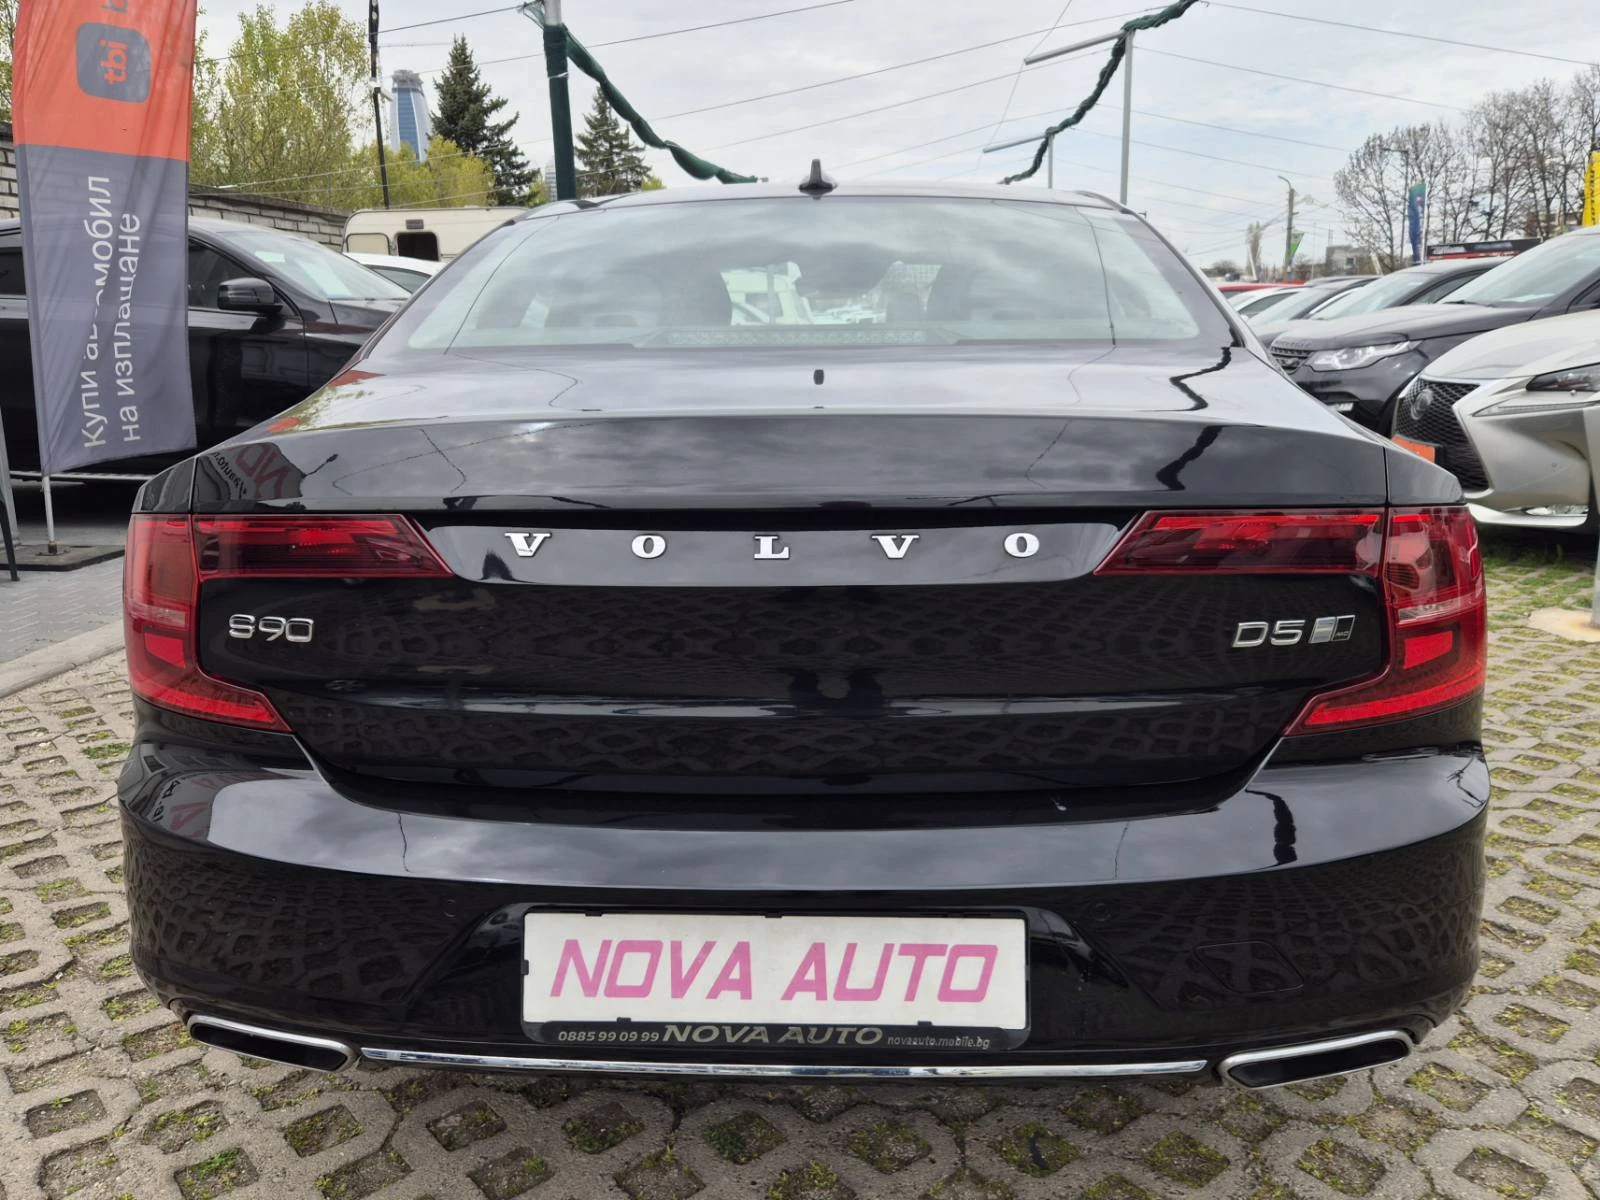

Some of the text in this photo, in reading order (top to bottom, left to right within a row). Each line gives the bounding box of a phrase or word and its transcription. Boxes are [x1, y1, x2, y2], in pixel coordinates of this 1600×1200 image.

[100, 39, 128, 85] tbi
[80, 176, 113, 448] Купи амобил
[114, 213, 141, 442] на изплащане
[504, 532, 1040, 559] VOLVO
[229, 614, 314, 642] S90
[1232, 620, 1306, 647] D5
[549, 939, 998, 1003] NOVA AUTO
[558, 1031, 660, 1042] 0885 99 09 99
[662, 1025, 883, 1045] NOVA AUTO
[887, 1036, 991, 1050] novaauto.mobile.bg
